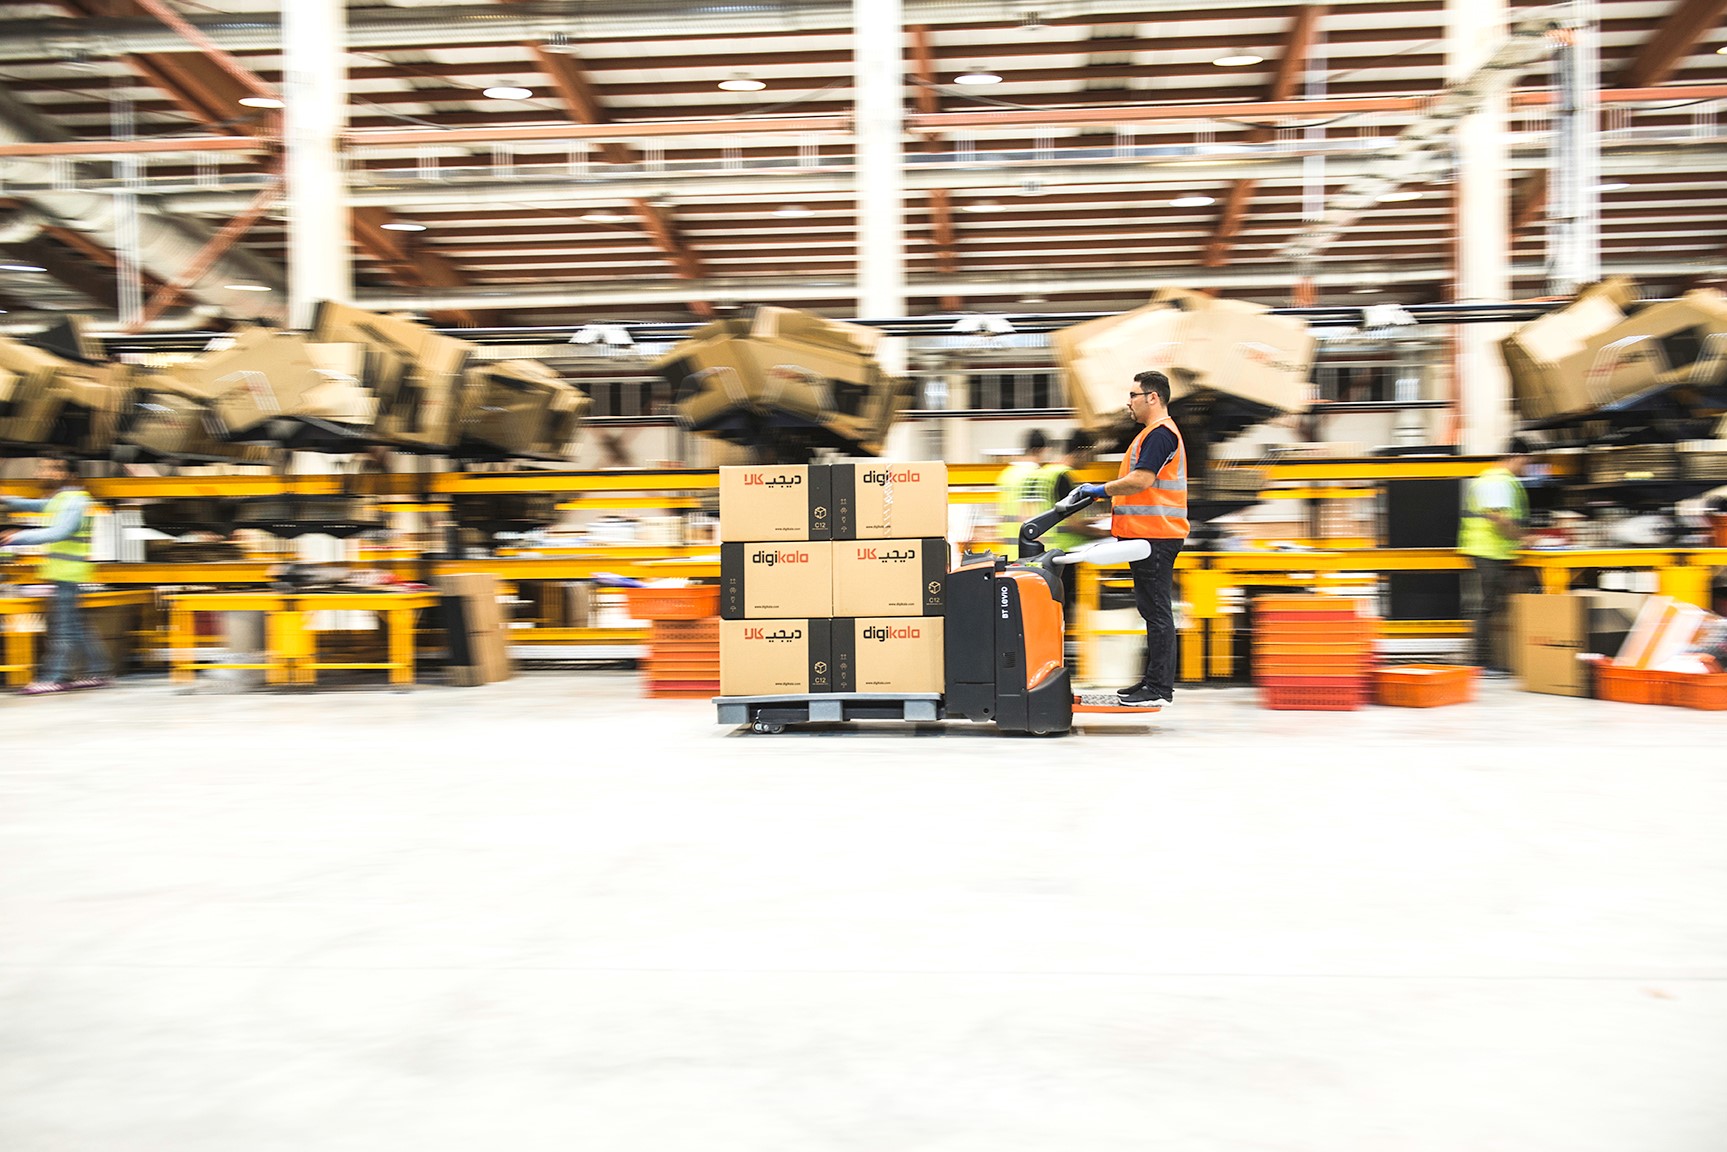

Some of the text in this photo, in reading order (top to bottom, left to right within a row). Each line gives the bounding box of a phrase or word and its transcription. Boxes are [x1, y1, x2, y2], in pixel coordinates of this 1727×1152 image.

[863, 469, 920, 486] digikala
[752, 550, 809, 567] digikala
[1001, 609, 1009, 619] BT
[863, 625, 920, 642] digikala
